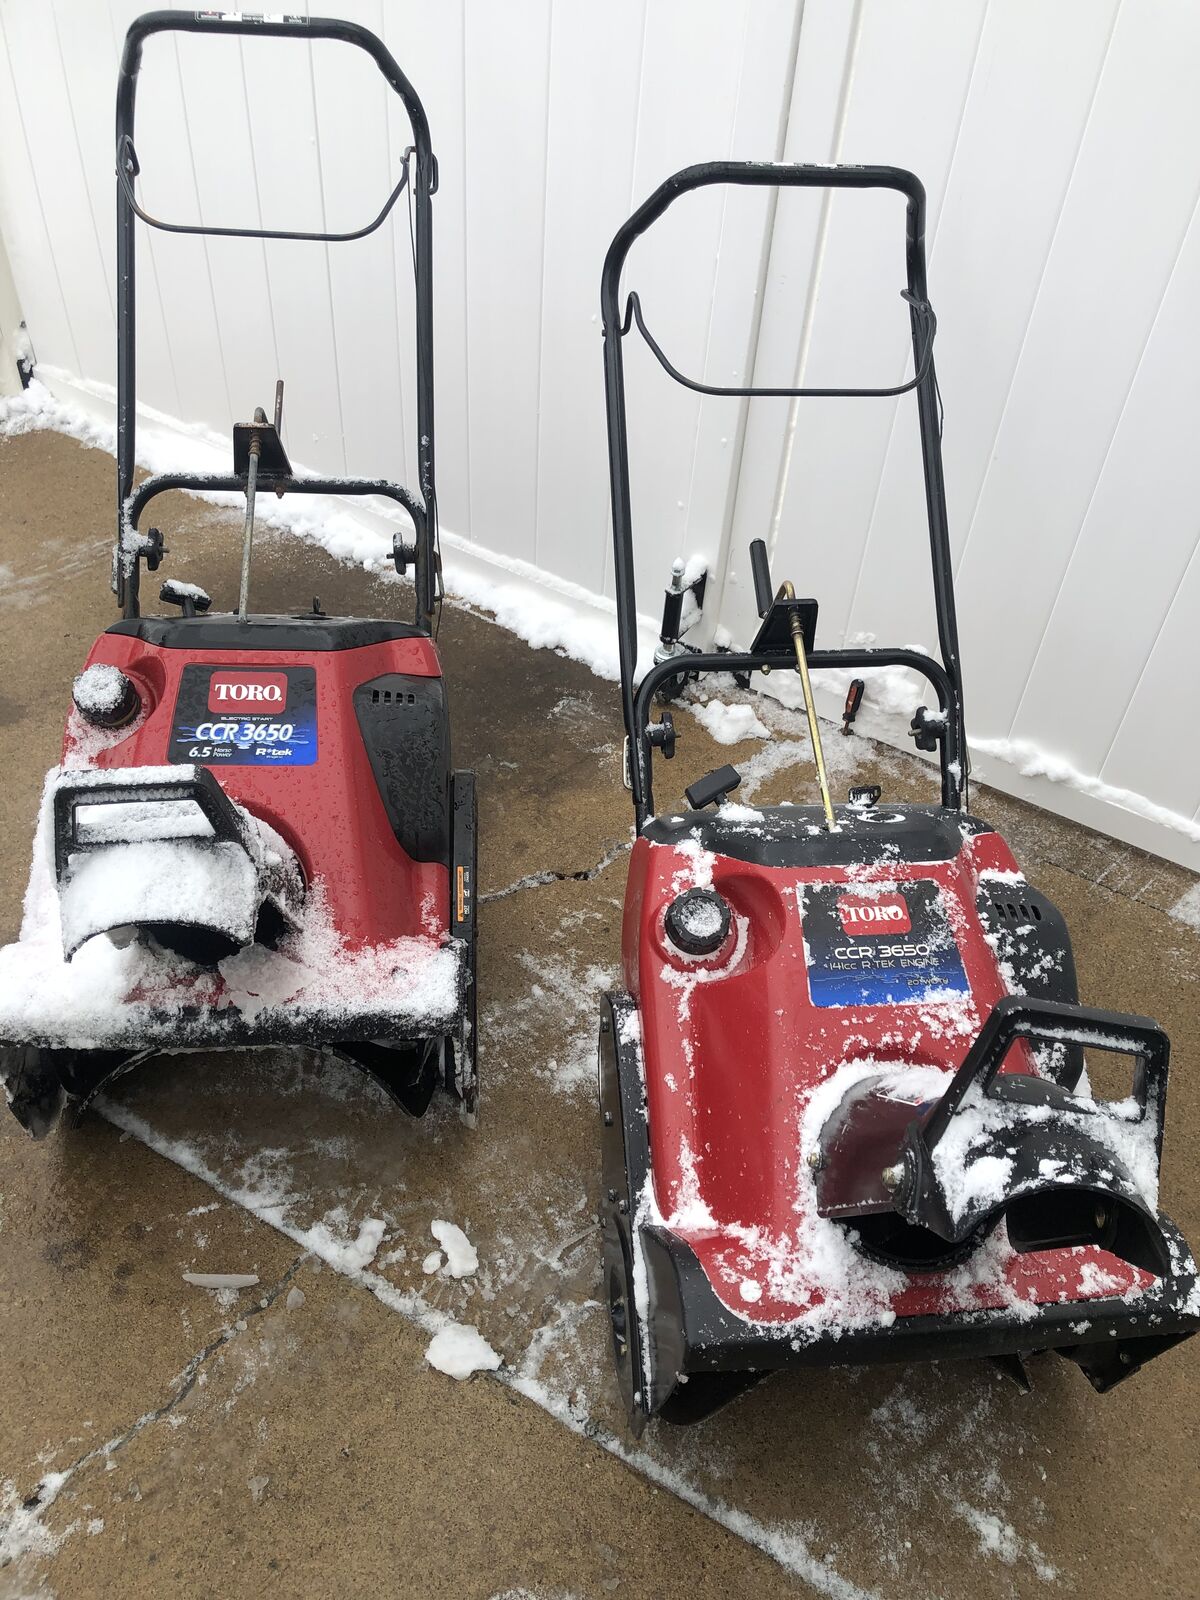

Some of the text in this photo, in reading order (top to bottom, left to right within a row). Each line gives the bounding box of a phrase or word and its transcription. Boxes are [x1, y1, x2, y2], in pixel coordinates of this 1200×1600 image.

[215, 684, 281, 700] TORO
[195, 722, 293, 741] CCR 3650
[189, 747, 212, 758] 6.5
[848, 905, 903, 922] TORO
[834, 944, 930, 960] CCR 3650
[901, 957, 940, 967] ENGINE
